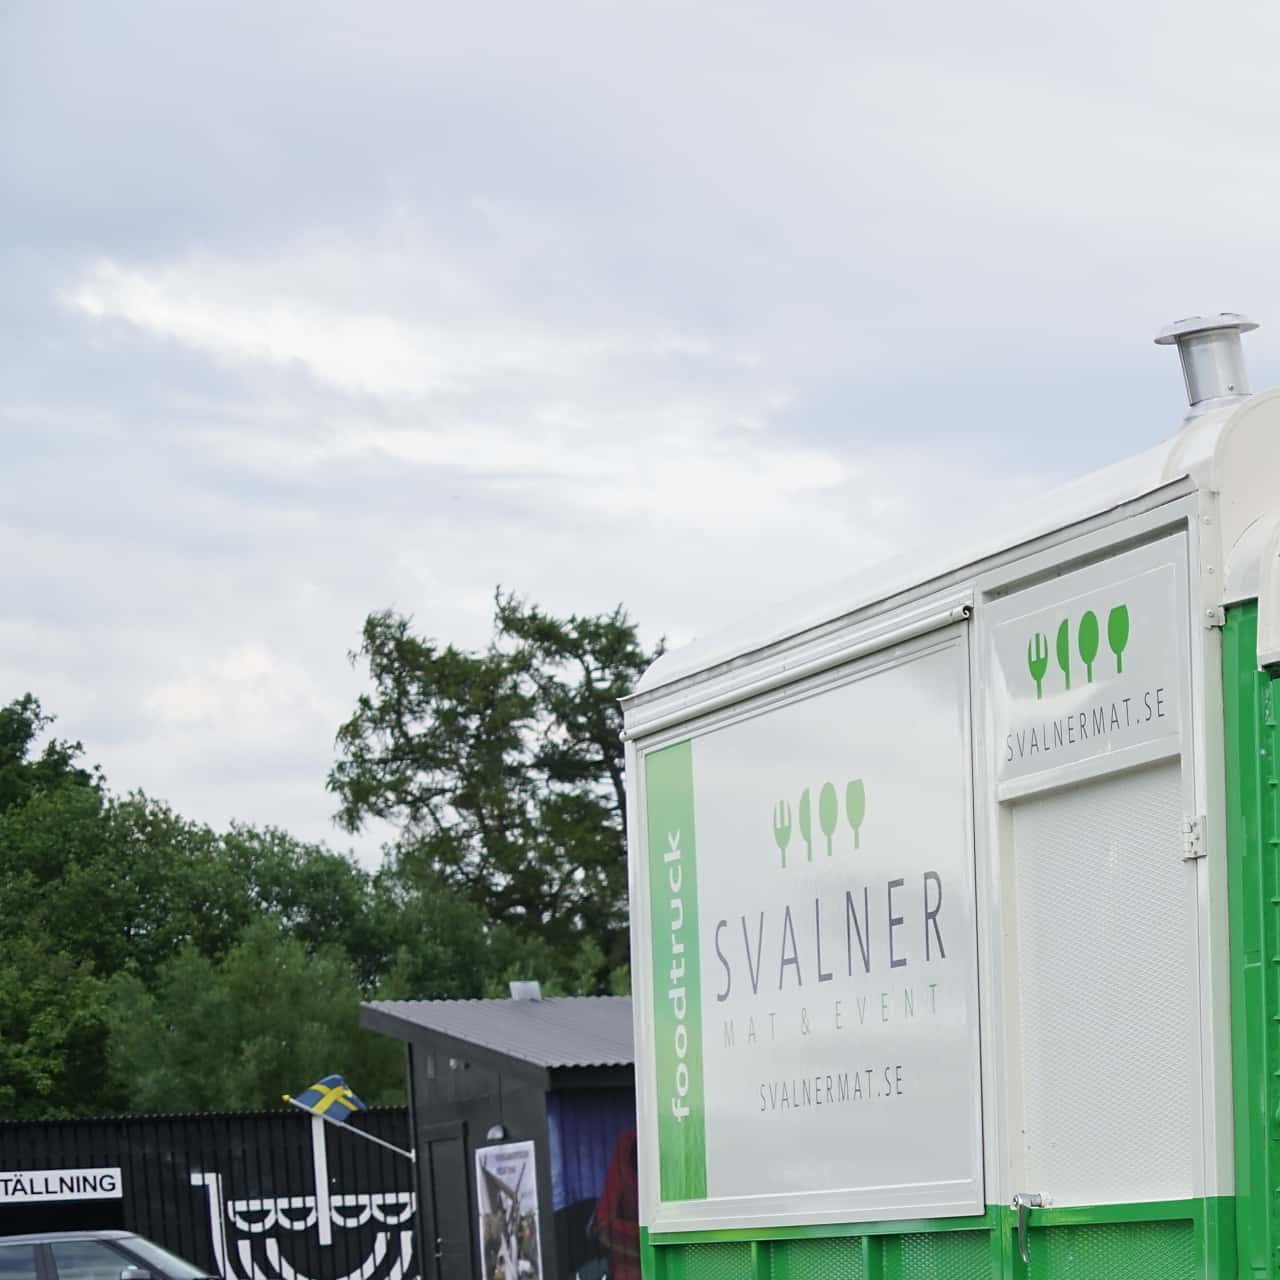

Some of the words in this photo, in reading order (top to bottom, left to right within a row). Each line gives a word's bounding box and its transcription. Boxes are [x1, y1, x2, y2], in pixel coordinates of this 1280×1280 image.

[1006, 687, 1166, 762] SVALNERMAT.SE
[715, 870, 946, 1003] SVALNER
[663, 829, 690, 1122] foodtruck
[723, 1012, 777, 1048] MAT
[800, 1007, 811, 1036] &
[835, 983, 938, 1030] EVENT
[760, 1065, 904, 1112] SVALNERMAT.SE
[0, 1174, 116, 1196] TÄLLNING
